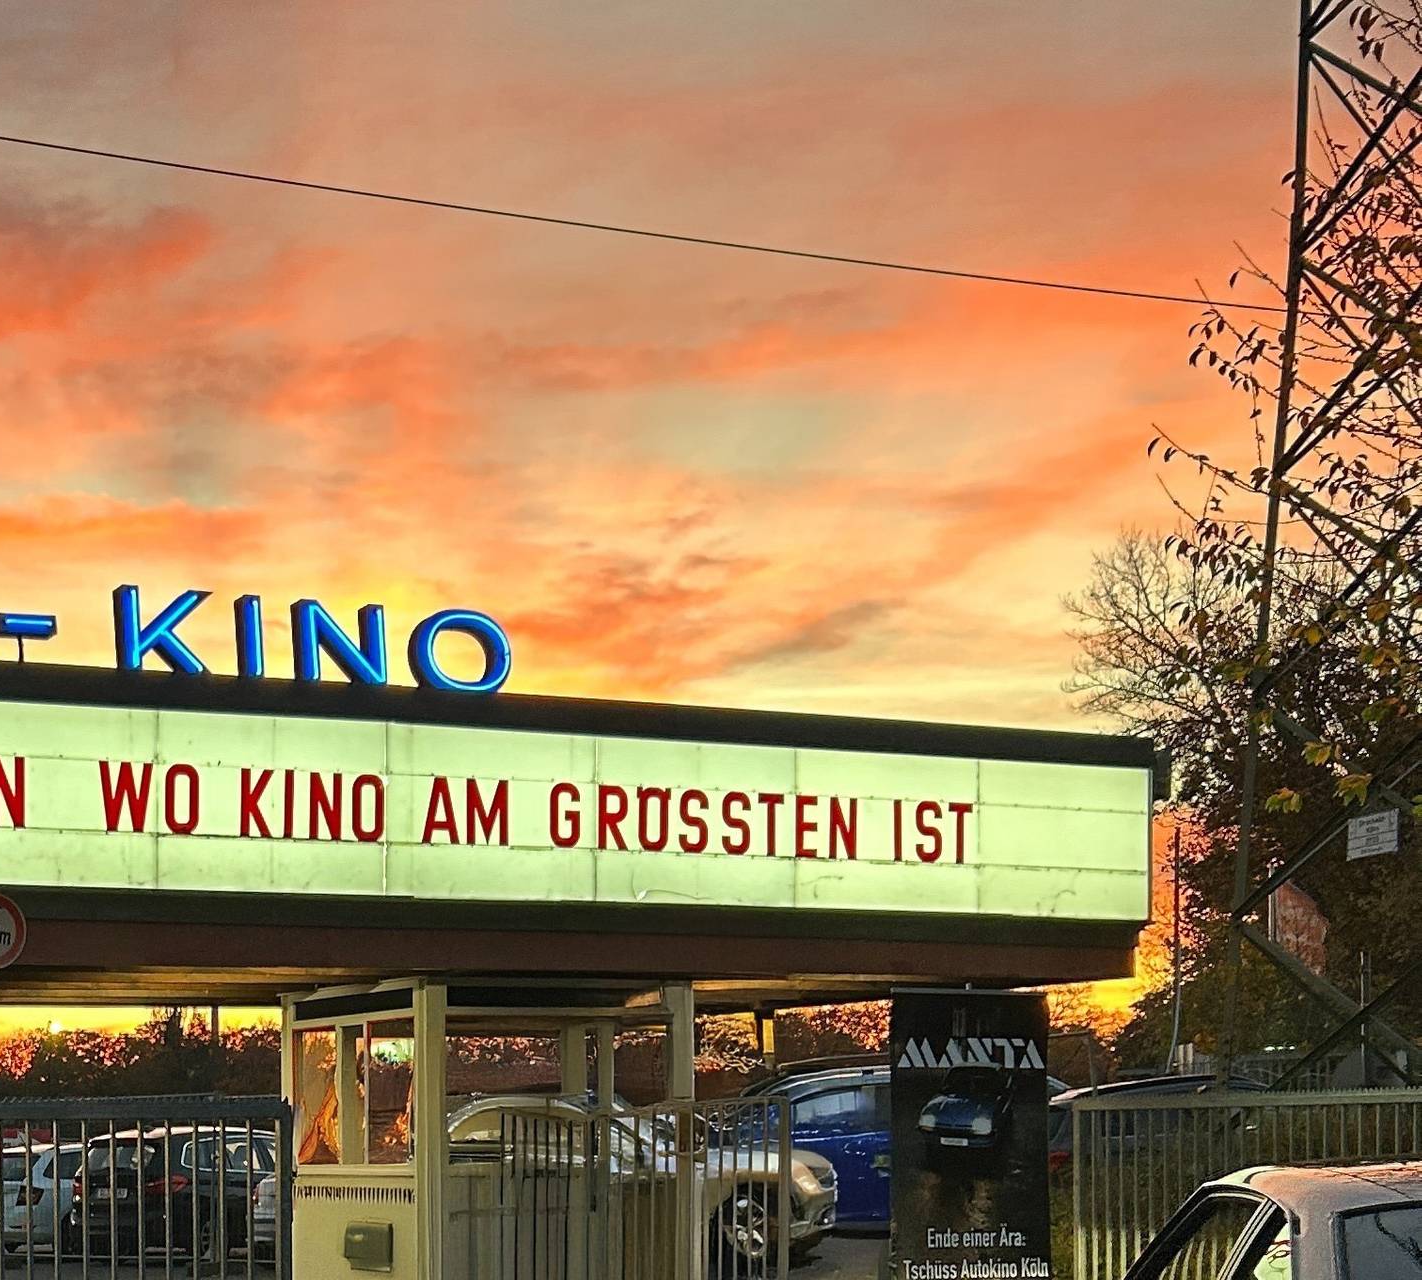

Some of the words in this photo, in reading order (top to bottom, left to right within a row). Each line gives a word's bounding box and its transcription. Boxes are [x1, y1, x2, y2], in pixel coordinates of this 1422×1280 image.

[113, 584, 512, 693] KINO
[99, 760, 200, 836] WO
[240, 768, 385, 842] KINO
[422, 776, 510, 846] AM
[549, 782, 858, 861] GRÖSSTEN
[893, 798, 974, 864] IST
[897, 1037, 1045, 1069] MANTA
[927, 1228, 959, 1248] Ende
[962, 1227, 996, 1247] einer
[999, 1223, 1026, 1247] Ära:
[903, 1260, 958, 1280] Tschüss
[960, 1258, 1017, 1278] Autokino
[1021, 1257, 1049, 1278] Köln
